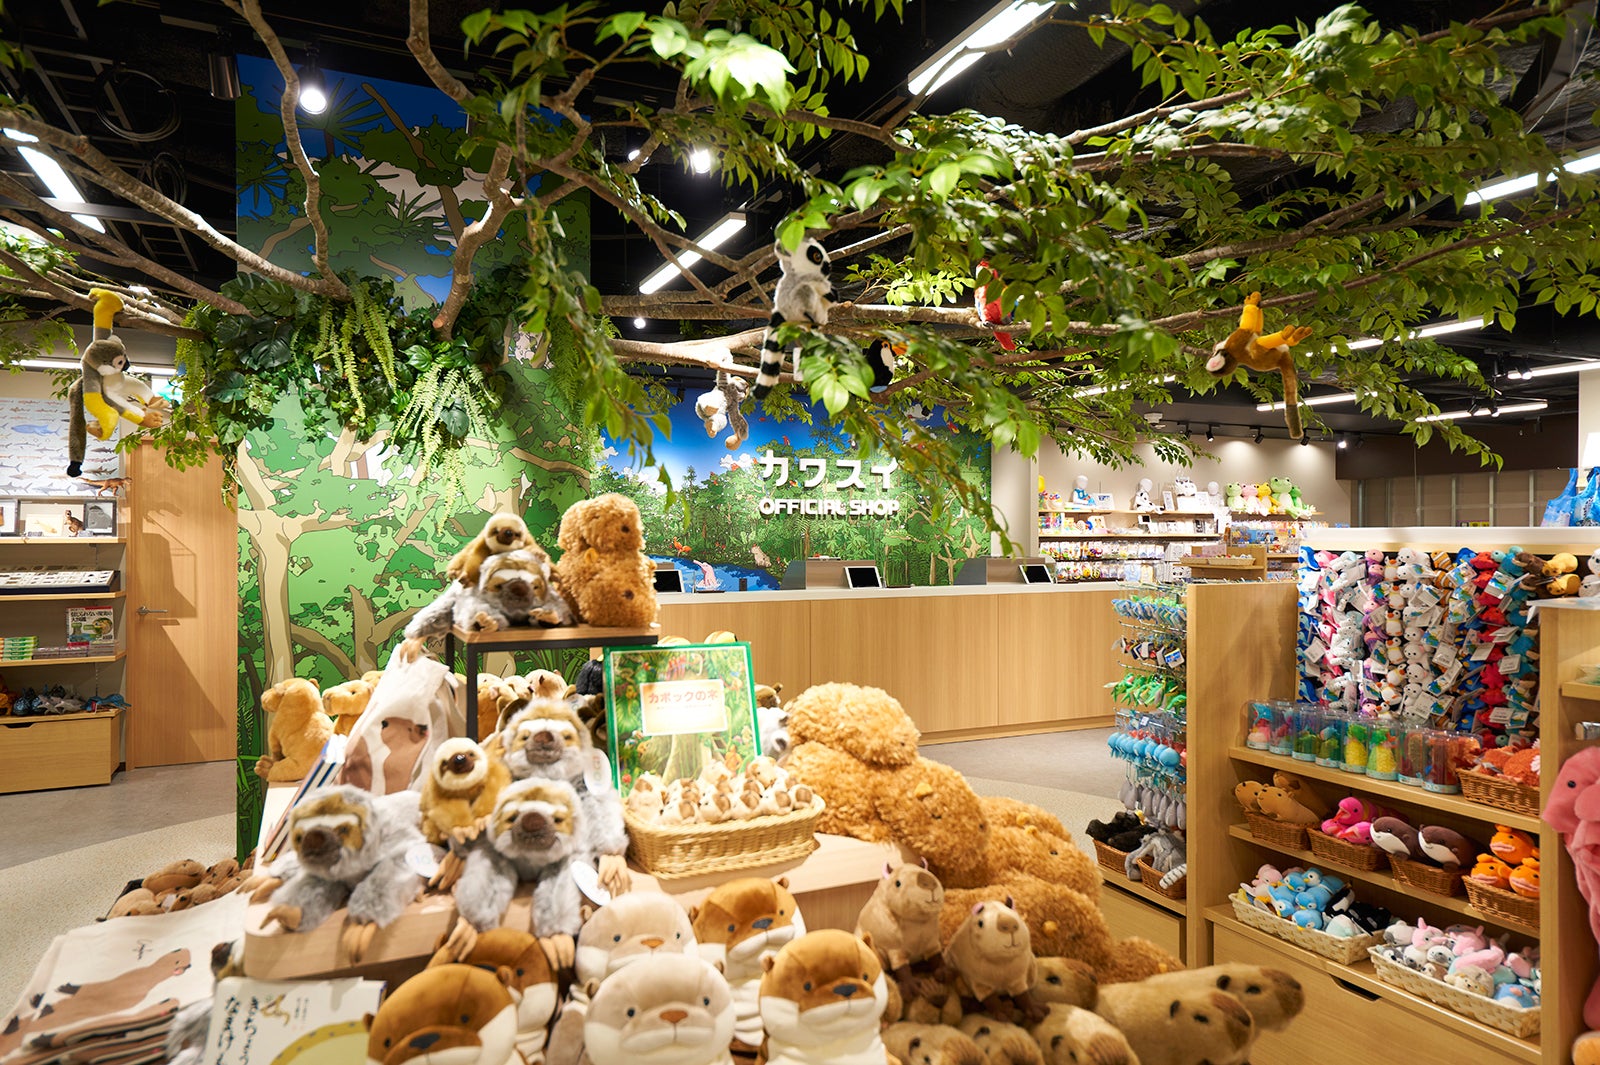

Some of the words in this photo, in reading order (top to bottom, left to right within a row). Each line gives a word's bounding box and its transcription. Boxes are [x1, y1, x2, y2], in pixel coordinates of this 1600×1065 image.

[760, 450, 898, 490] カワスイ
[759, 499, 846, 516] OFFICIAL
[850, 499, 899, 516] SHOP
